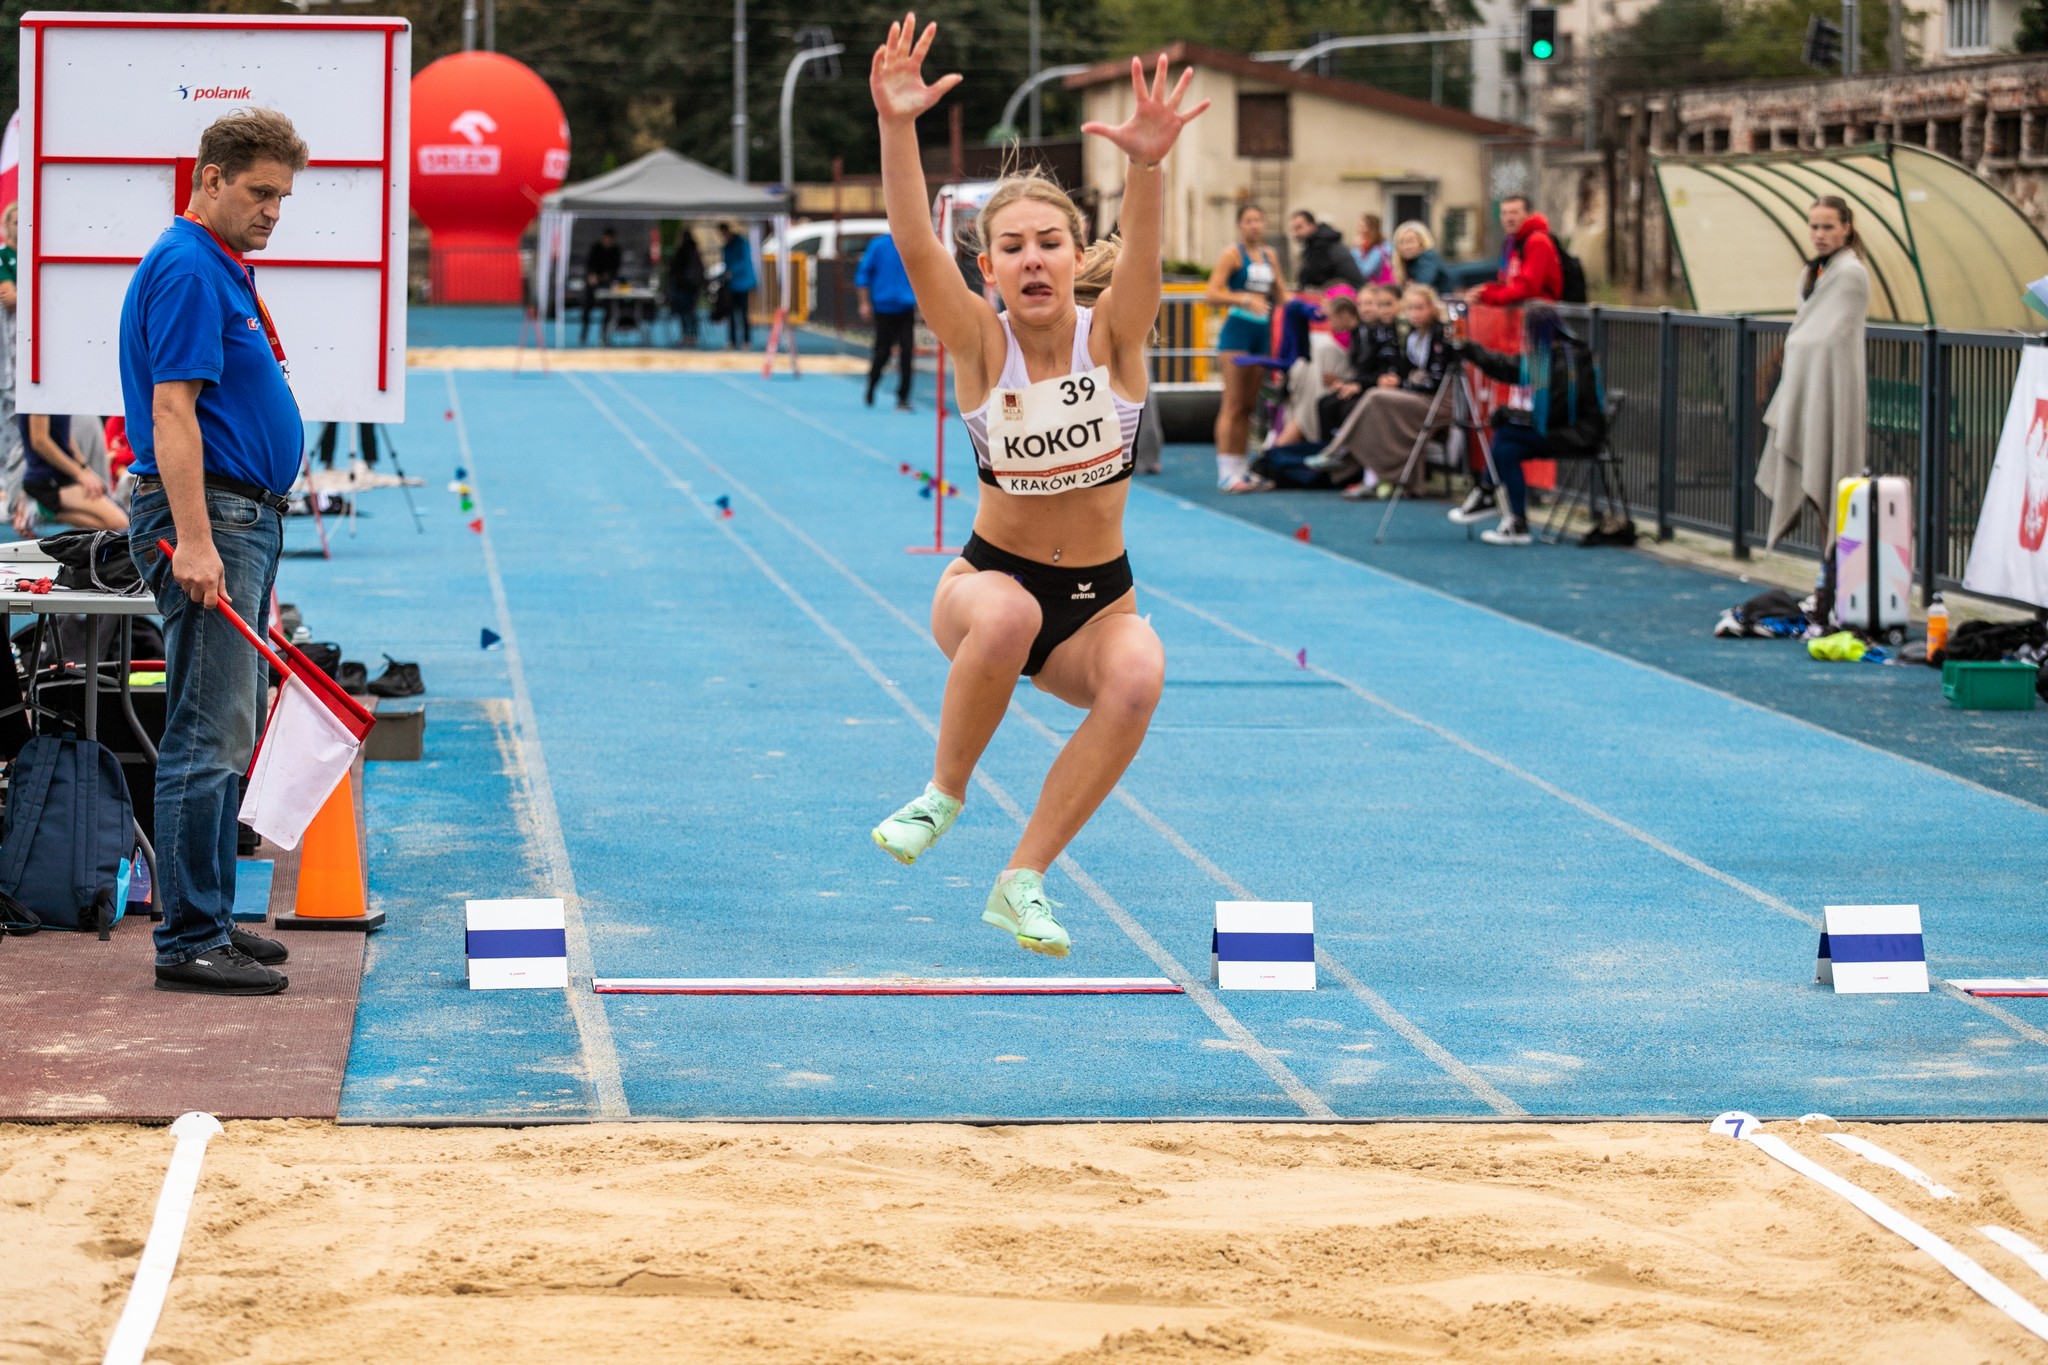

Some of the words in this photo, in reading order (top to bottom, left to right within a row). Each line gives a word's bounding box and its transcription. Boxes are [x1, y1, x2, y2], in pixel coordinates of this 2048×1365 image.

[193, 86, 252, 101] polanik
[1060, 376, 1096, 406] 39
[1003, 417, 1104, 459] KOKOT
[1010, 474, 1077, 492] KRAKÓW
[1081, 463, 1114, 484] 2022
[1724, 1118, 1745, 1139] 7
